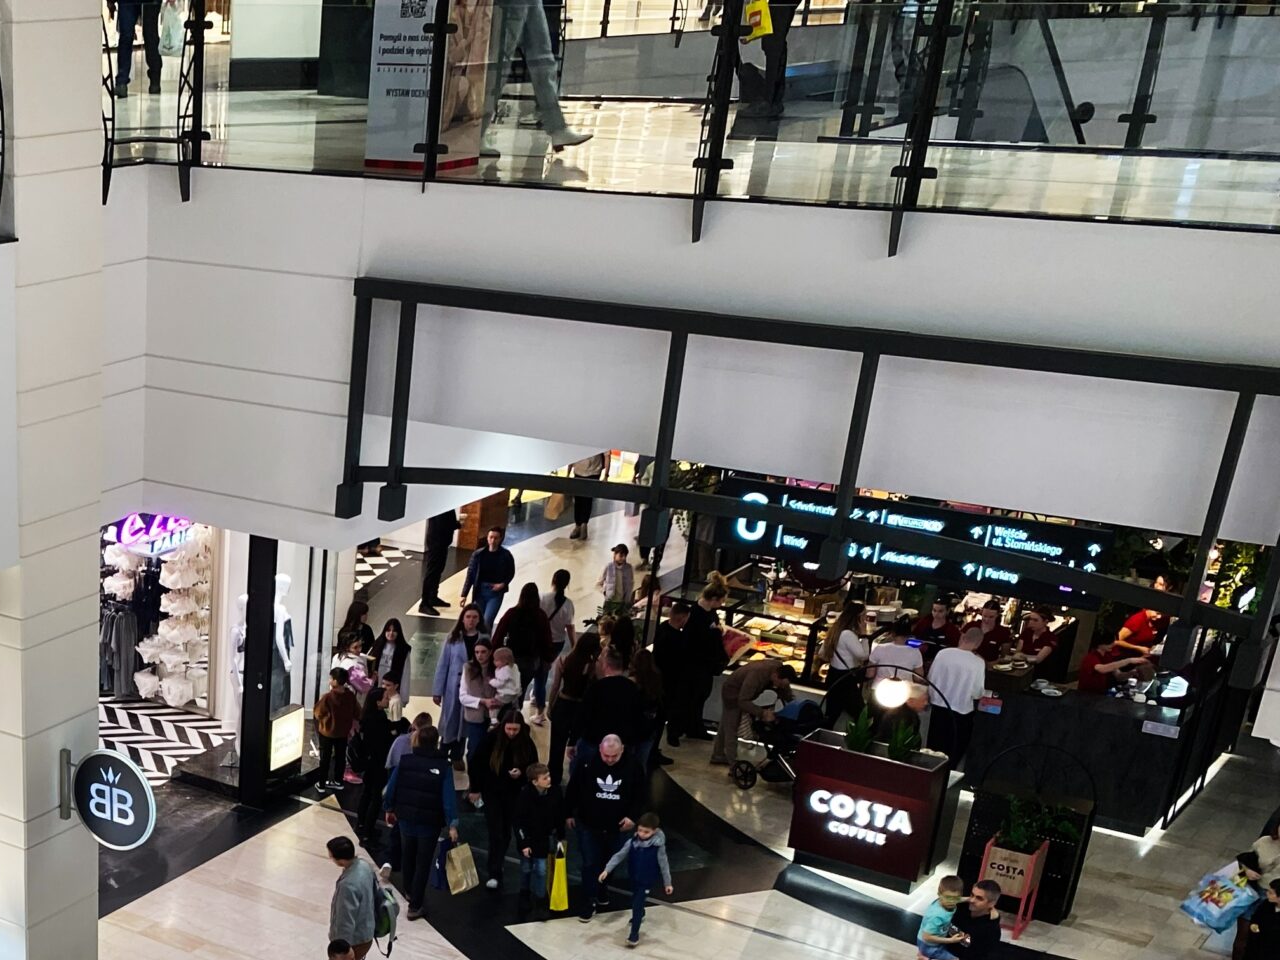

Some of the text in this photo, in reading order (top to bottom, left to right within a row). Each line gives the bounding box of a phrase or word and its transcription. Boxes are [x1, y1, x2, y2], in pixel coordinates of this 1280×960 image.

[994, 526, 1028, 541] Wejście
[783, 534, 808, 550] Windy
[984, 567, 1019, 584] Parking
[595, 792, 621, 800] adidas
[809, 789, 913, 836] COSTA
[828, 820, 887, 846] COFFEE
[990, 861, 1025, 877] COSTA
